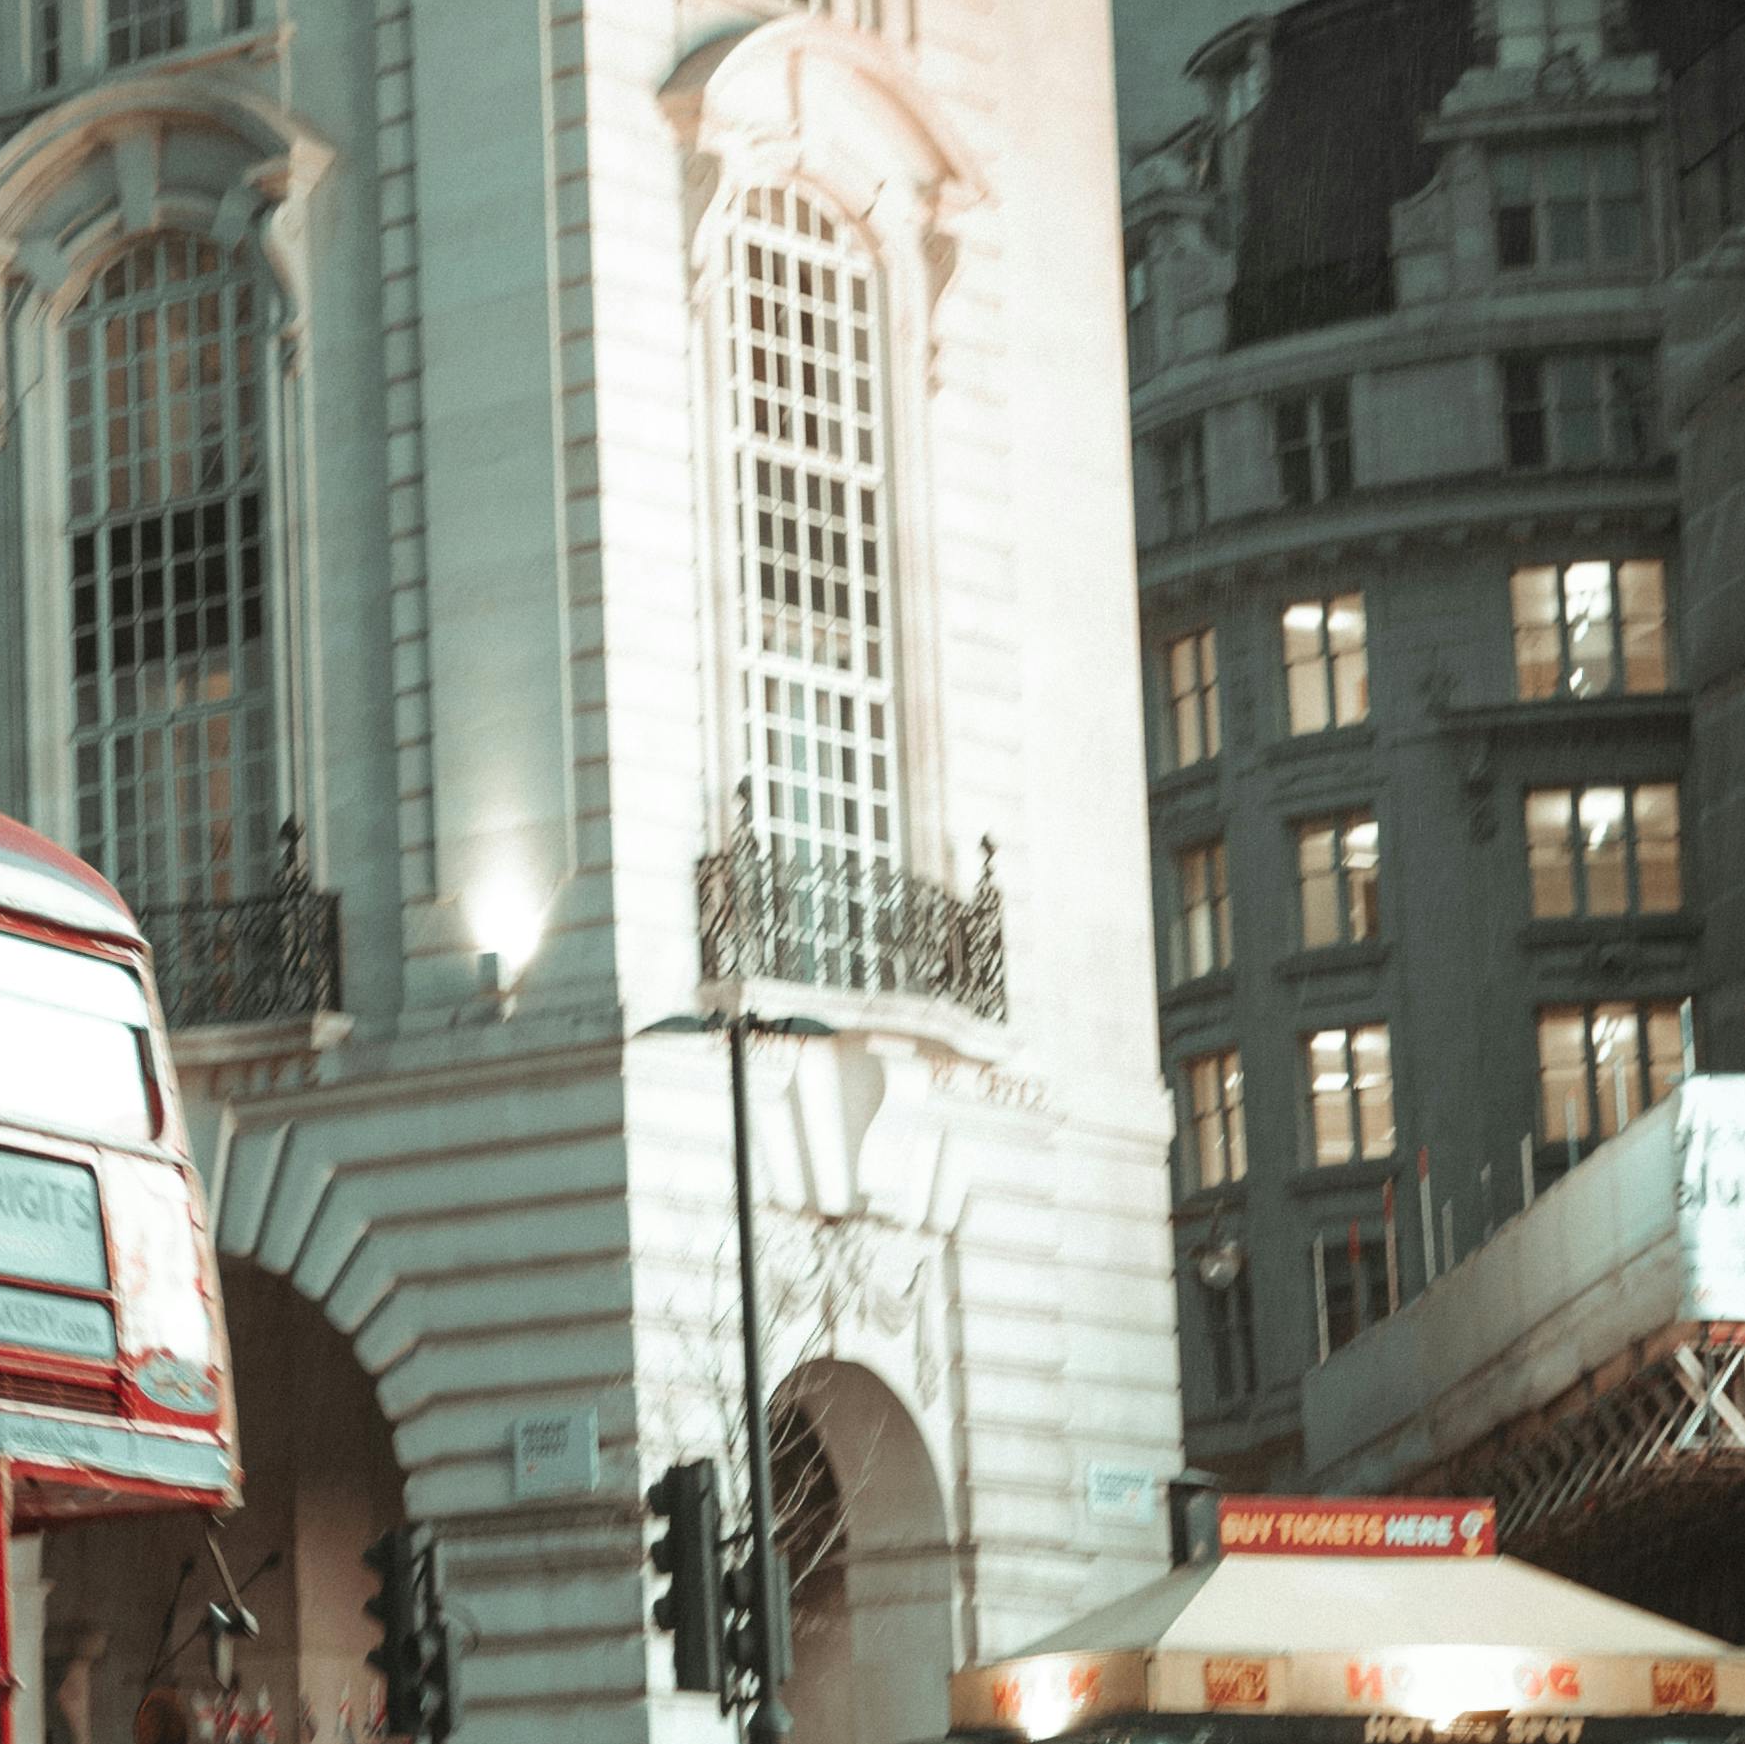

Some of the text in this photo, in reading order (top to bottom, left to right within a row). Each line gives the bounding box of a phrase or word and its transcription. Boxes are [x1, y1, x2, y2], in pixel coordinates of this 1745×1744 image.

[1221, 1511, 1455, 1547] BUY TICKETS HERE
